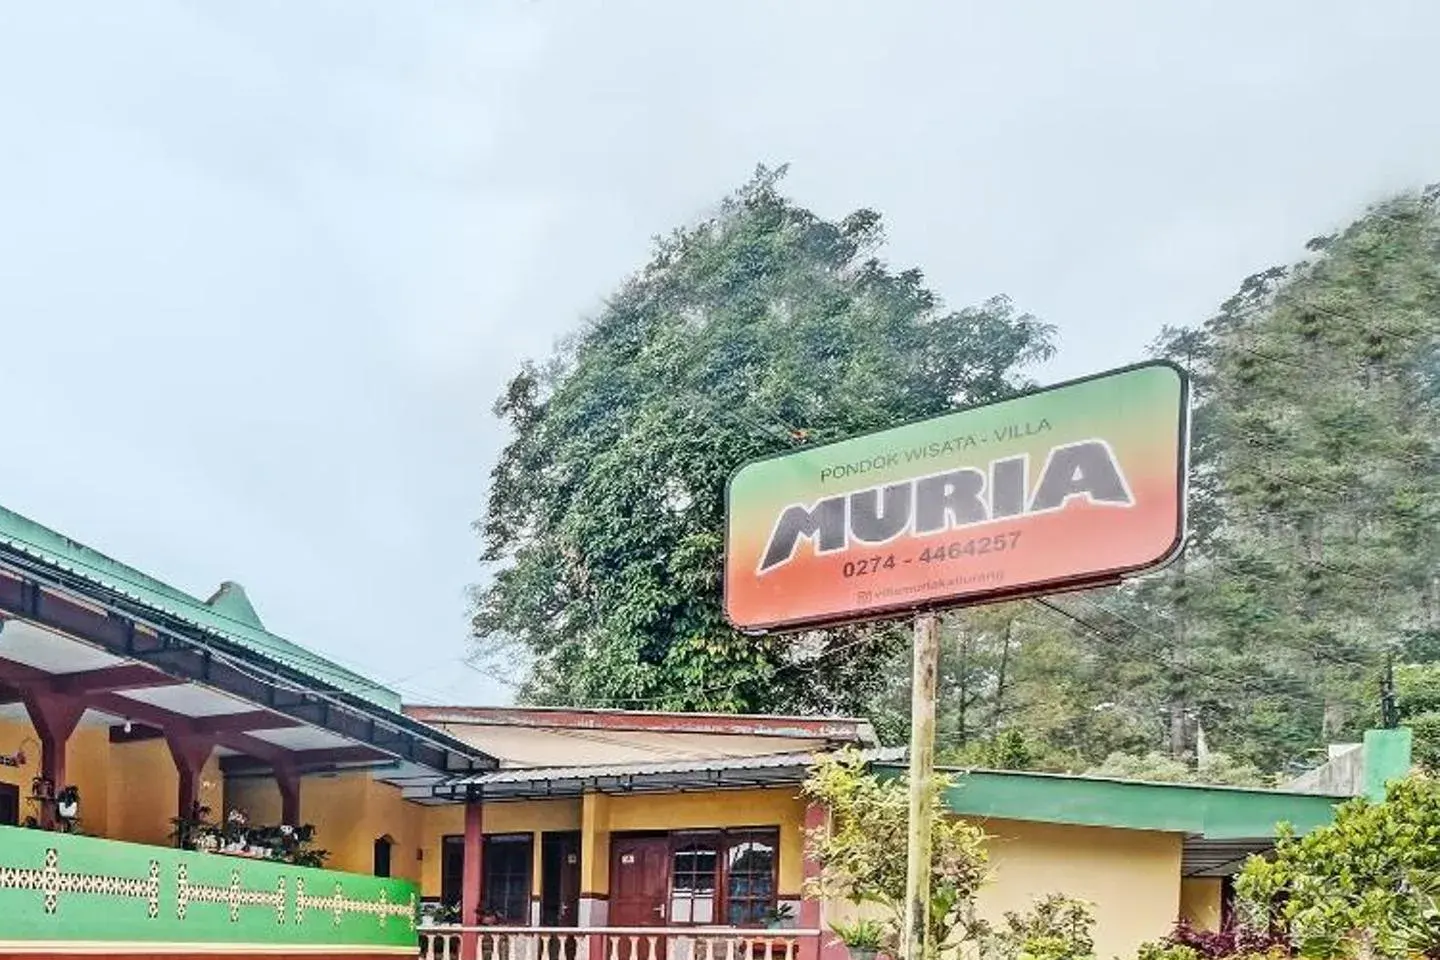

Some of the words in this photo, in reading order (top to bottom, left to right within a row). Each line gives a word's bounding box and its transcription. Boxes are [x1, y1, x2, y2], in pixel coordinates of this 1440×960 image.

[820, 453, 899, 482] PONDOK
[904, 436, 976, 462] WISATA
[994, 418, 1052, 442] VILLA
[756, 438, 1135, 576] MURIA
[843, 554, 896, 578] 0274
[919, 531, 1022, 564] 4464257
